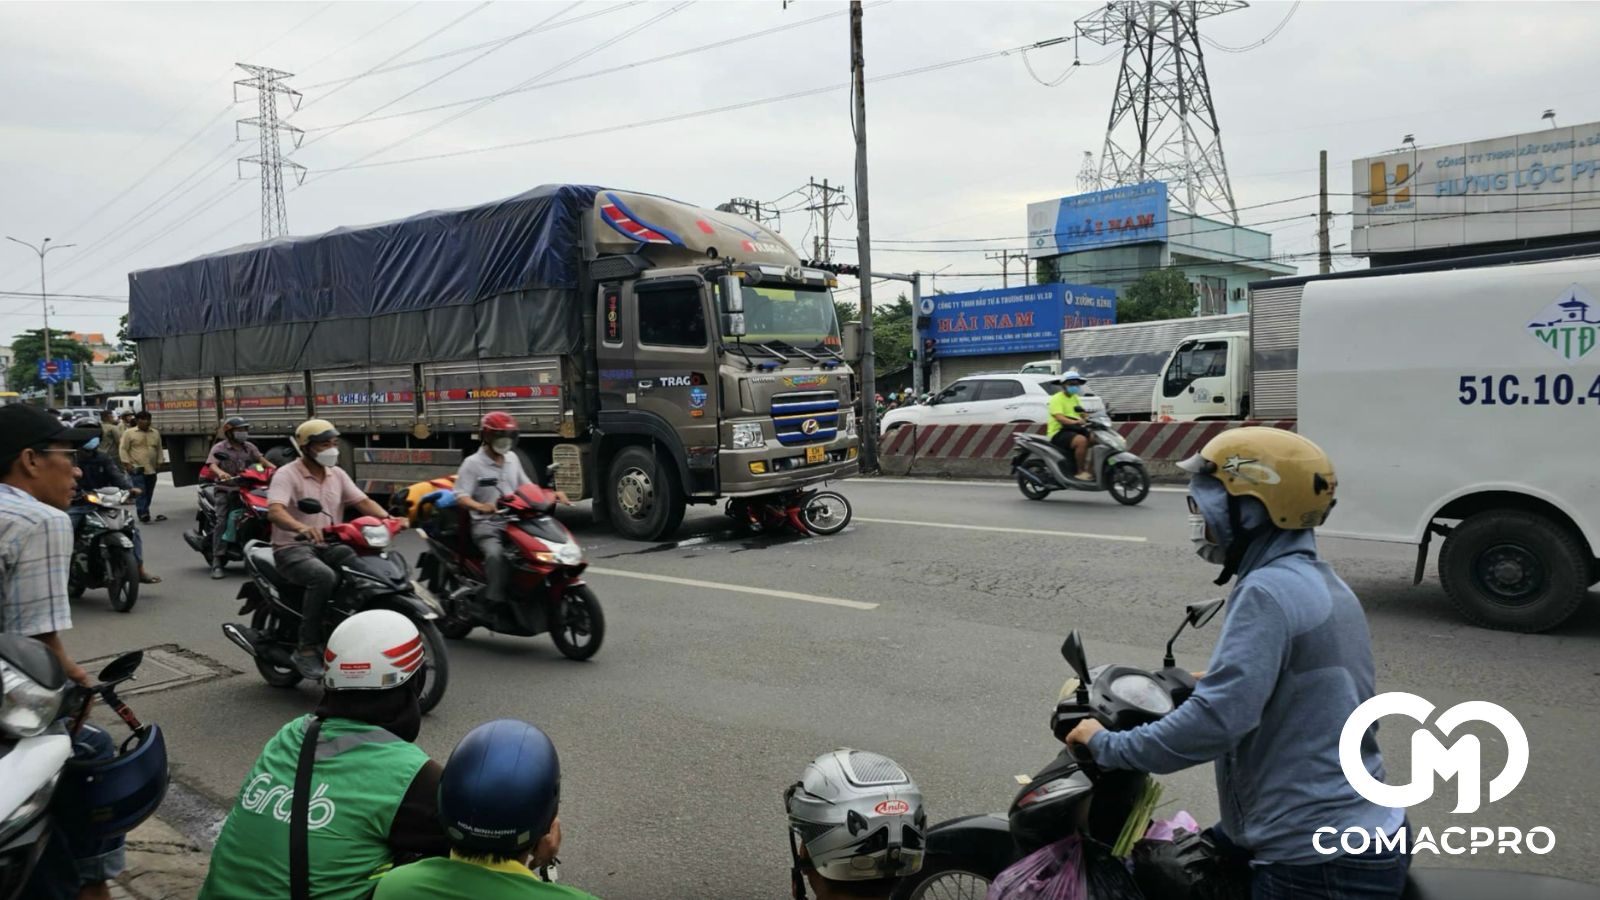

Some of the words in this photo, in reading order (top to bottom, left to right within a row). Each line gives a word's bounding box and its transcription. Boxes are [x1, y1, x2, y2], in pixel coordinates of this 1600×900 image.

[1436, 155, 1467, 169] CÔNG
[1470, 154, 1483, 164] TY
[1486, 149, 1516, 162] TNHH
[1436, 172, 1508, 197] HƯNG
[1515, 162, 1565, 190] LỘC
[938, 311, 978, 332] HẢI
[984, 311, 1034, 329] NAM
[468, 389, 498, 398] TRAGO
[241, 772, 335, 830] Grab
